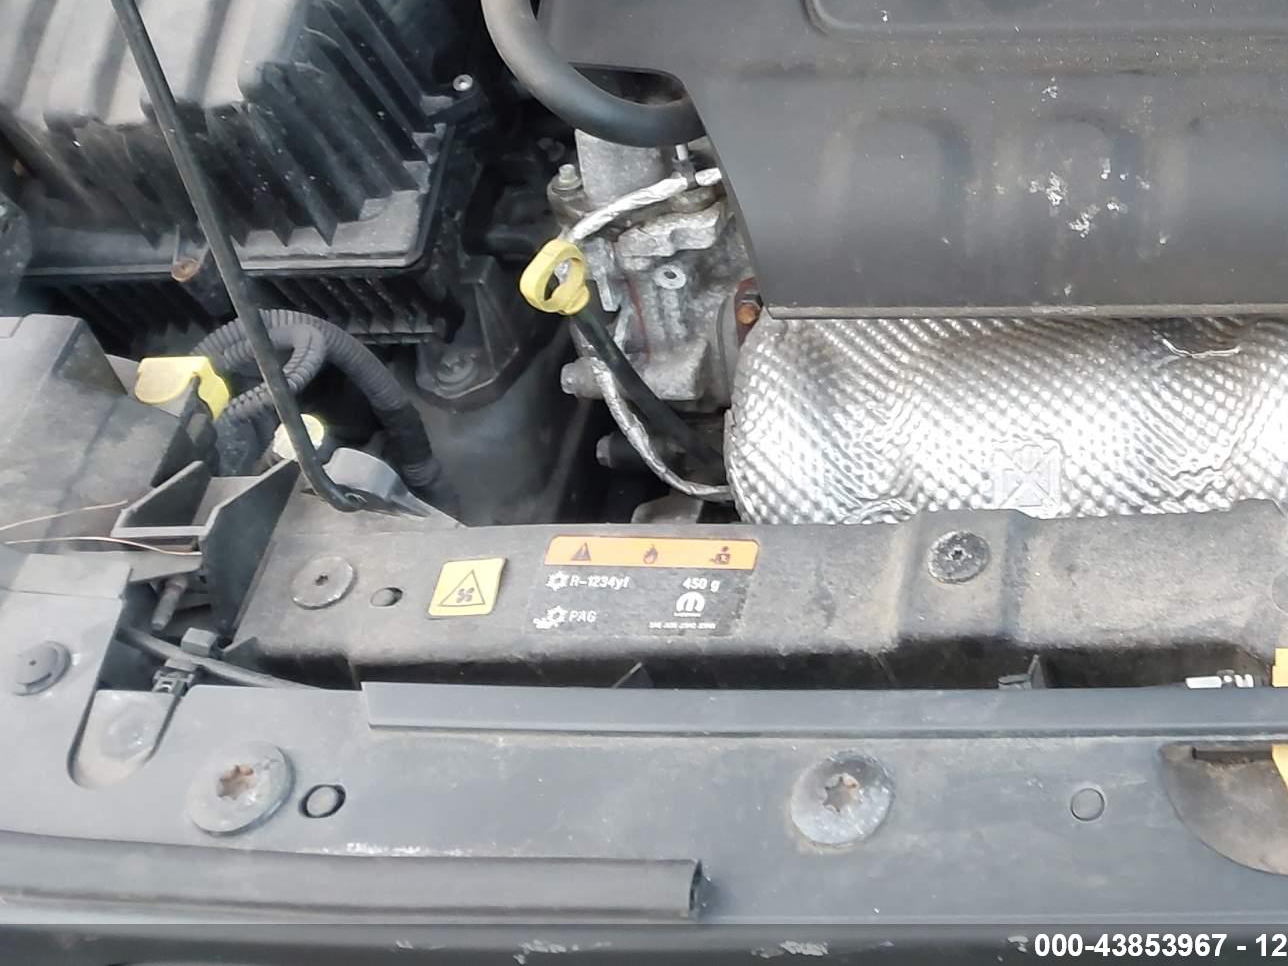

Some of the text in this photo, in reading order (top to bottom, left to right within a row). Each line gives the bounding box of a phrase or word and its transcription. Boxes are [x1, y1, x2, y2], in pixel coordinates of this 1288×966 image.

[569, 575, 630, 591] R-1234yf
[682, 577, 721, 593] 450 g
[568, 610, 598, 624] PAG
